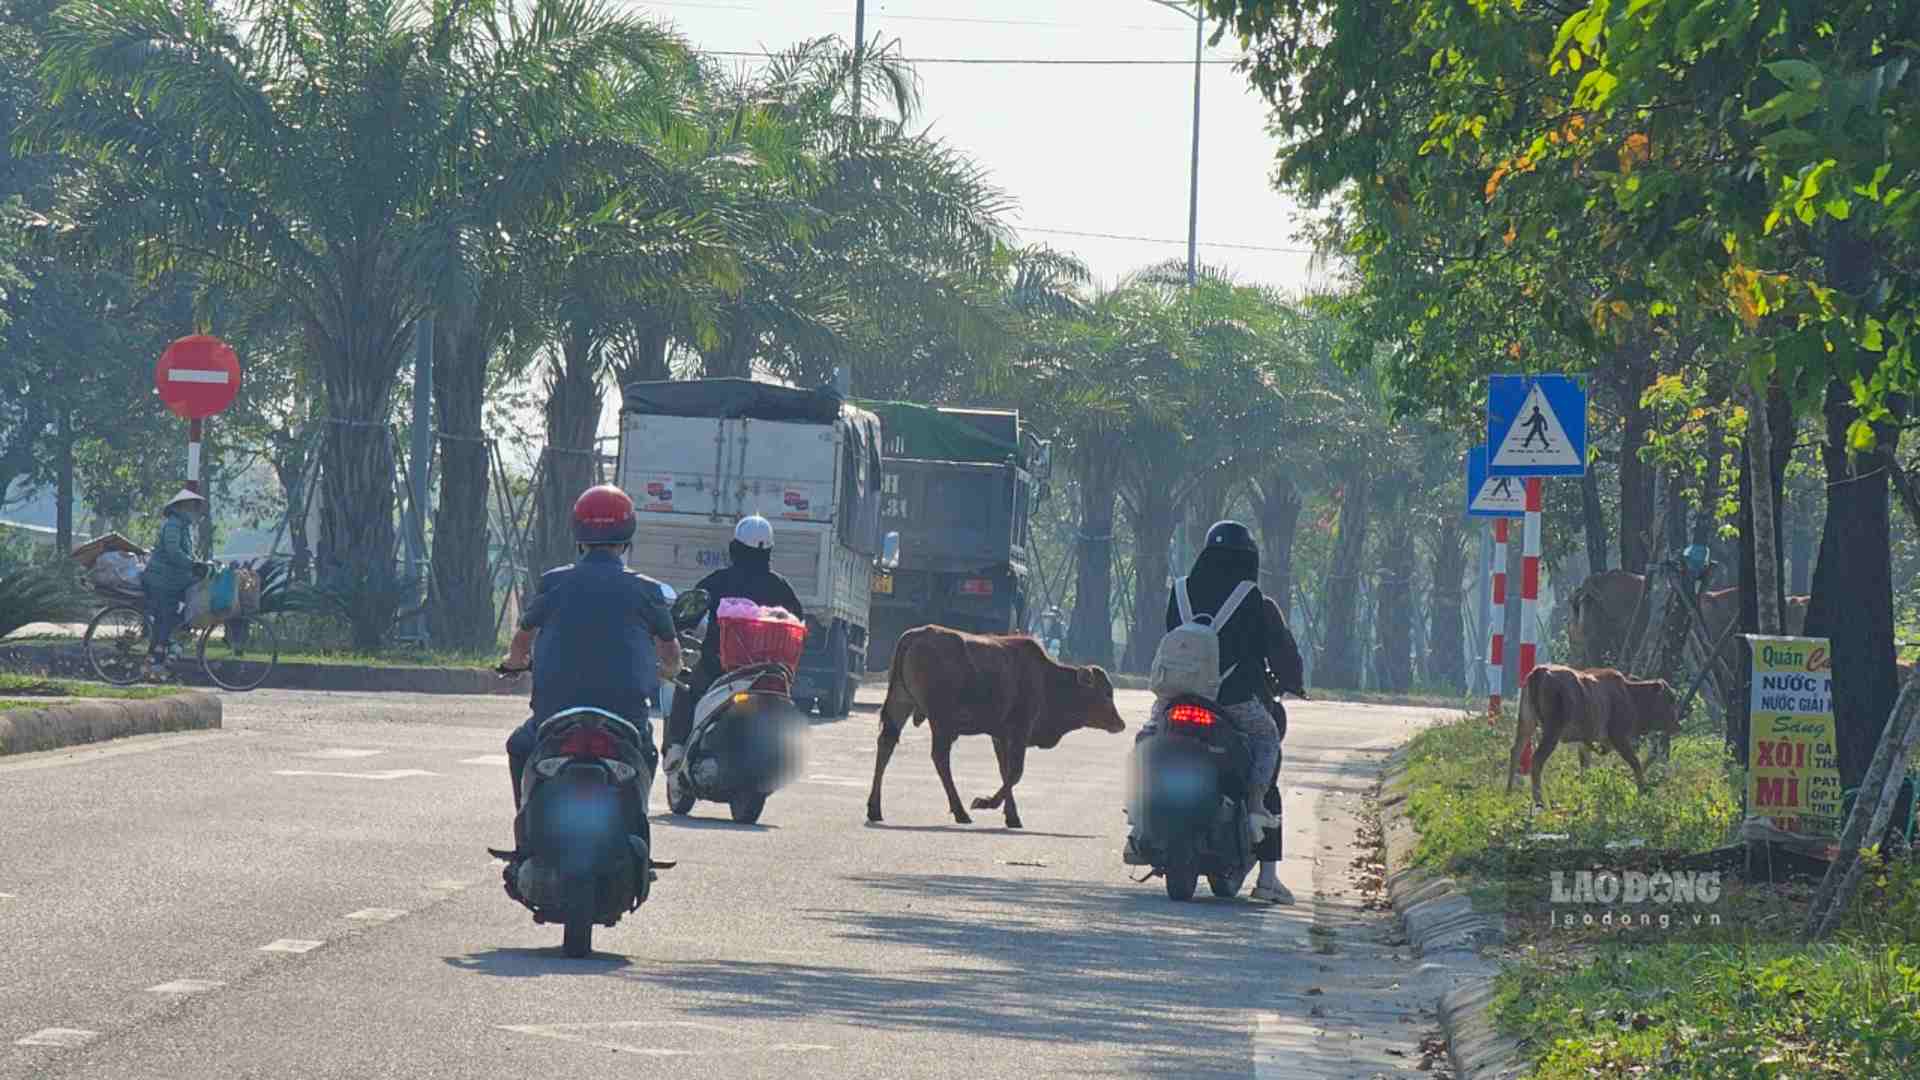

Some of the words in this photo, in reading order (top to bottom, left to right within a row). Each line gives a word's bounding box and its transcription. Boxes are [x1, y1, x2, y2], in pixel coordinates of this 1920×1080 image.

[1763, 645, 1802, 668] Quán
[1763, 675, 1816, 692] NƯỚC
[1758, 736, 1806, 769] XÔI
[1756, 770, 1799, 807] MÌ
